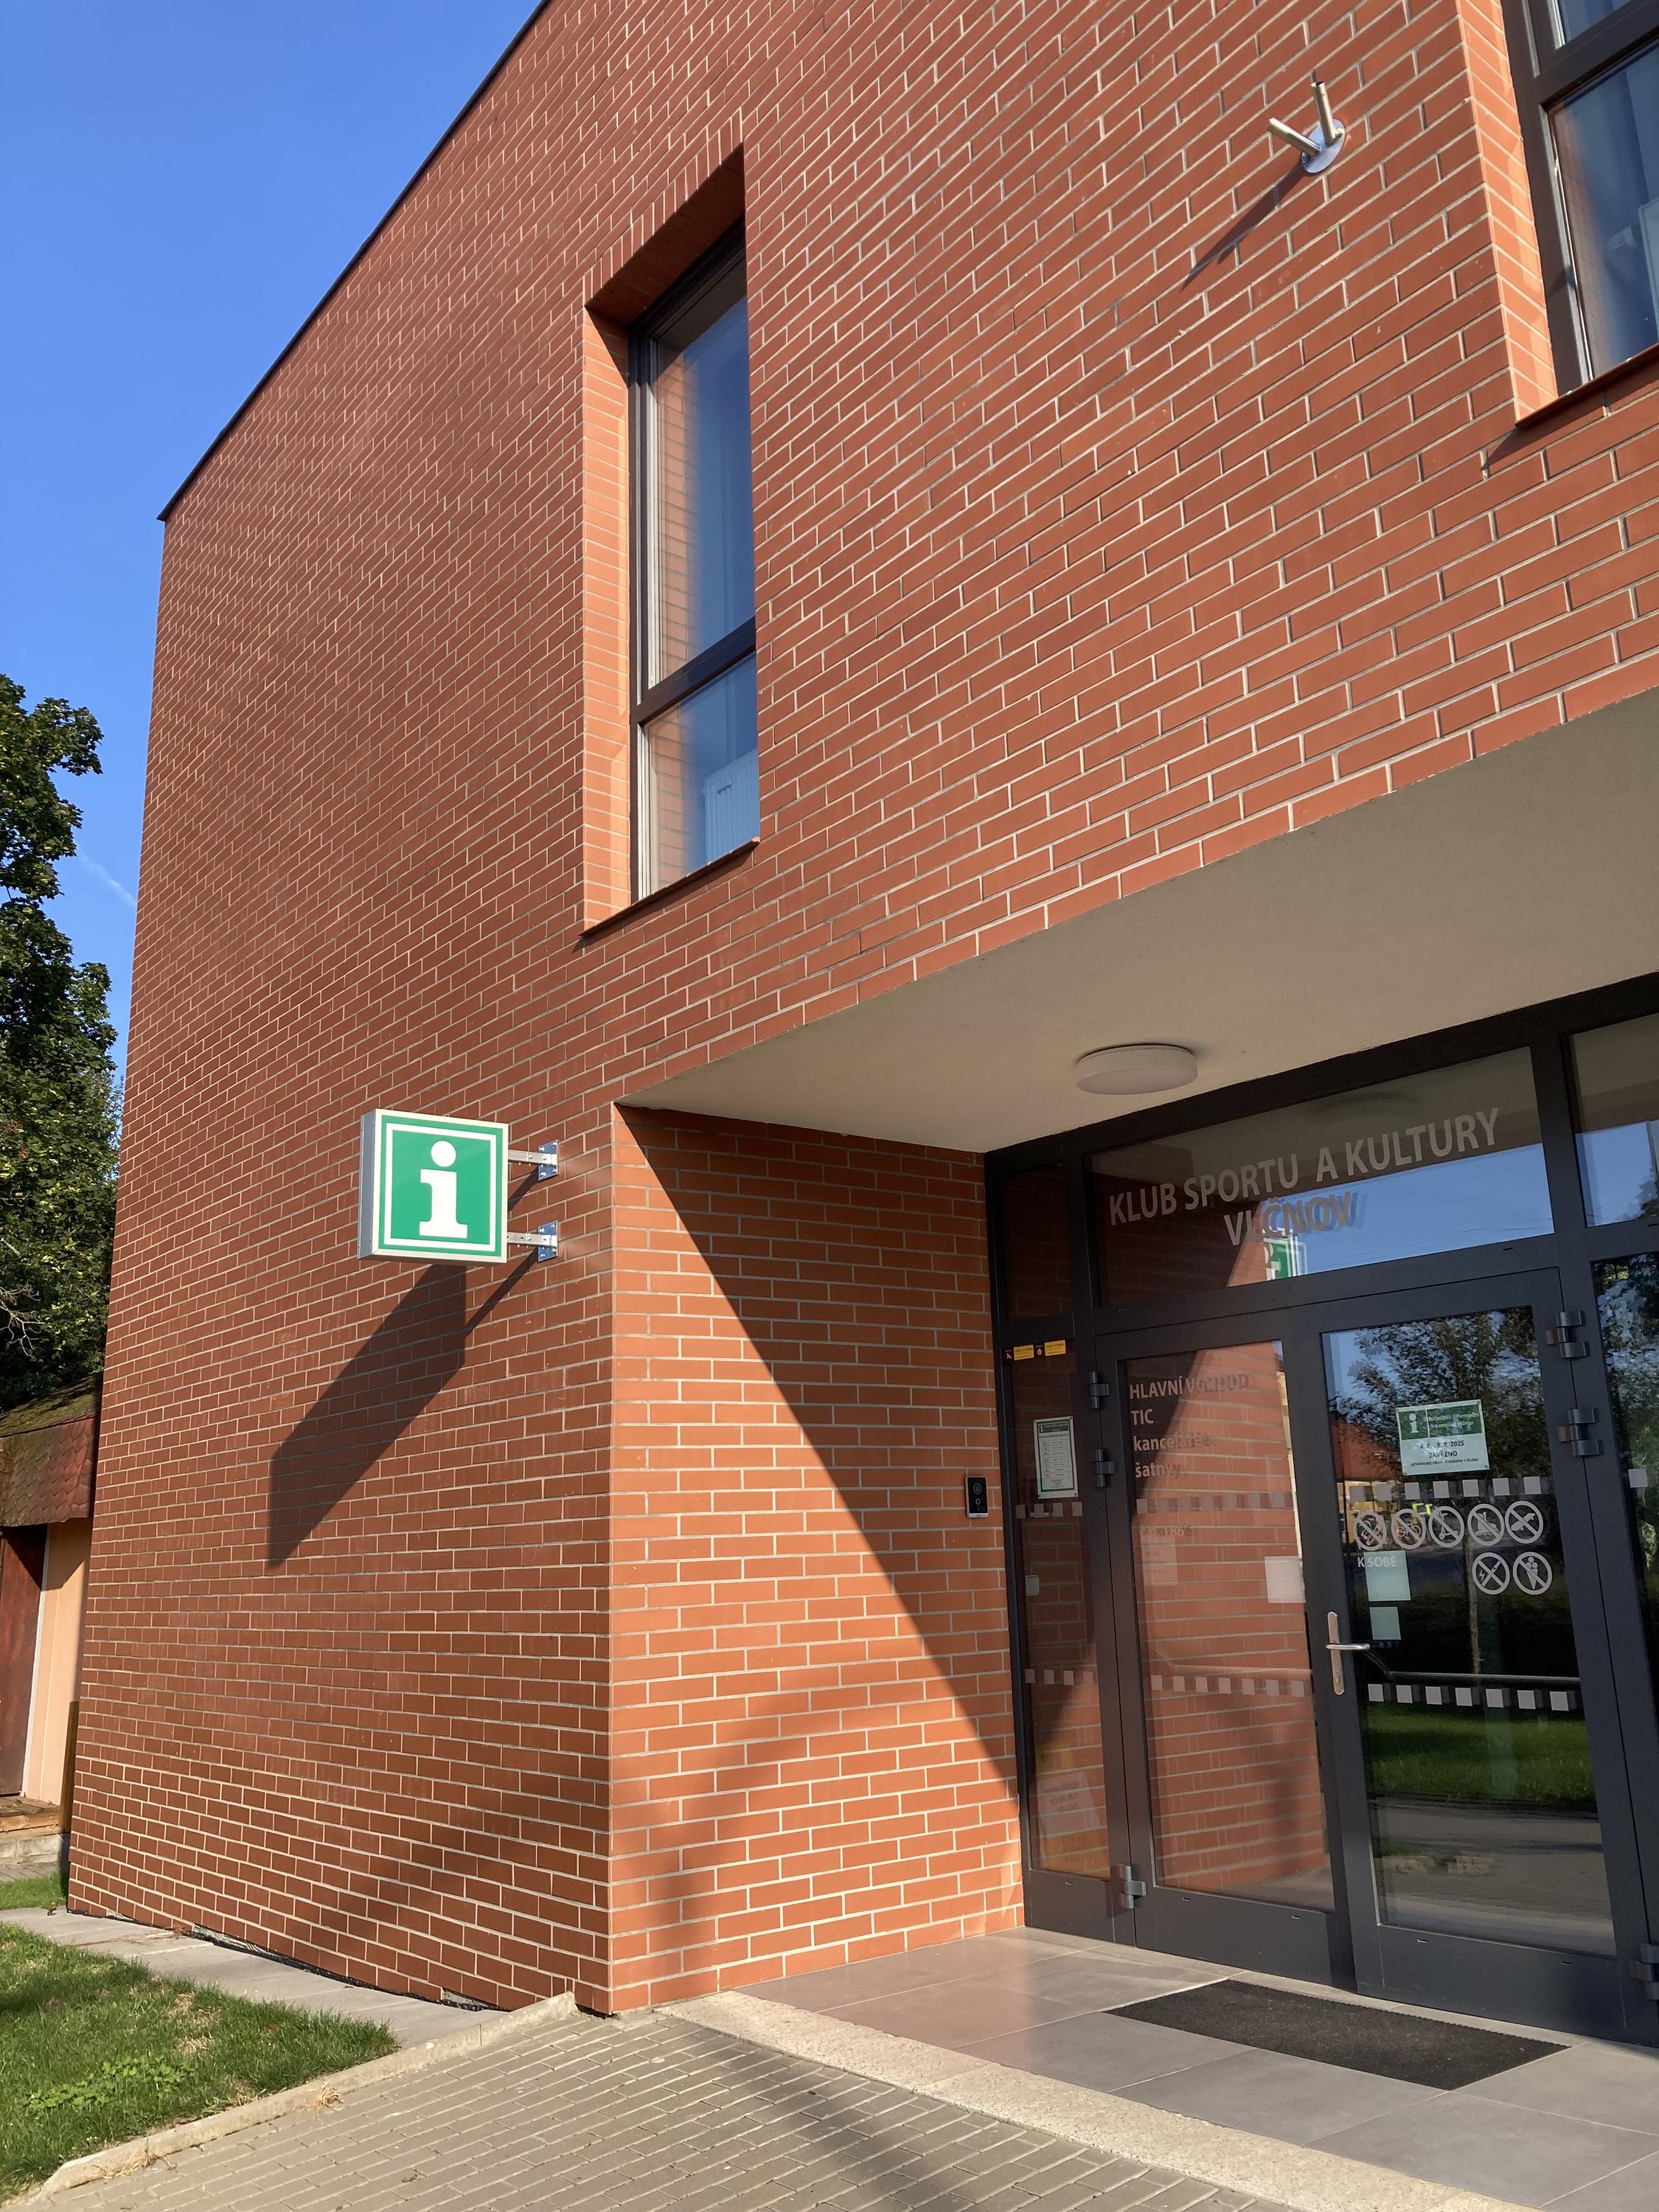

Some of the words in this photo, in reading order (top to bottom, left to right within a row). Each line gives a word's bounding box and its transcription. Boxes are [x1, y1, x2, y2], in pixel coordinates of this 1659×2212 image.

[1110, 1183, 1178, 1225] KLUB
[1183, 1154, 1298, 1210] SPORTU
[1316, 1147, 1339, 1182] A
[1345, 1107, 1499, 1176] KULTURY
[1129, 1375, 1183, 1399] HLAVNÍ
[1131, 1408, 1154, 1425] TIC
[1429, 1450, 1458, 1458] ZAVŘENO
[1357, 1557, 1365, 1568] K
[1368, 1554, 1397, 1568] SOBĚ
